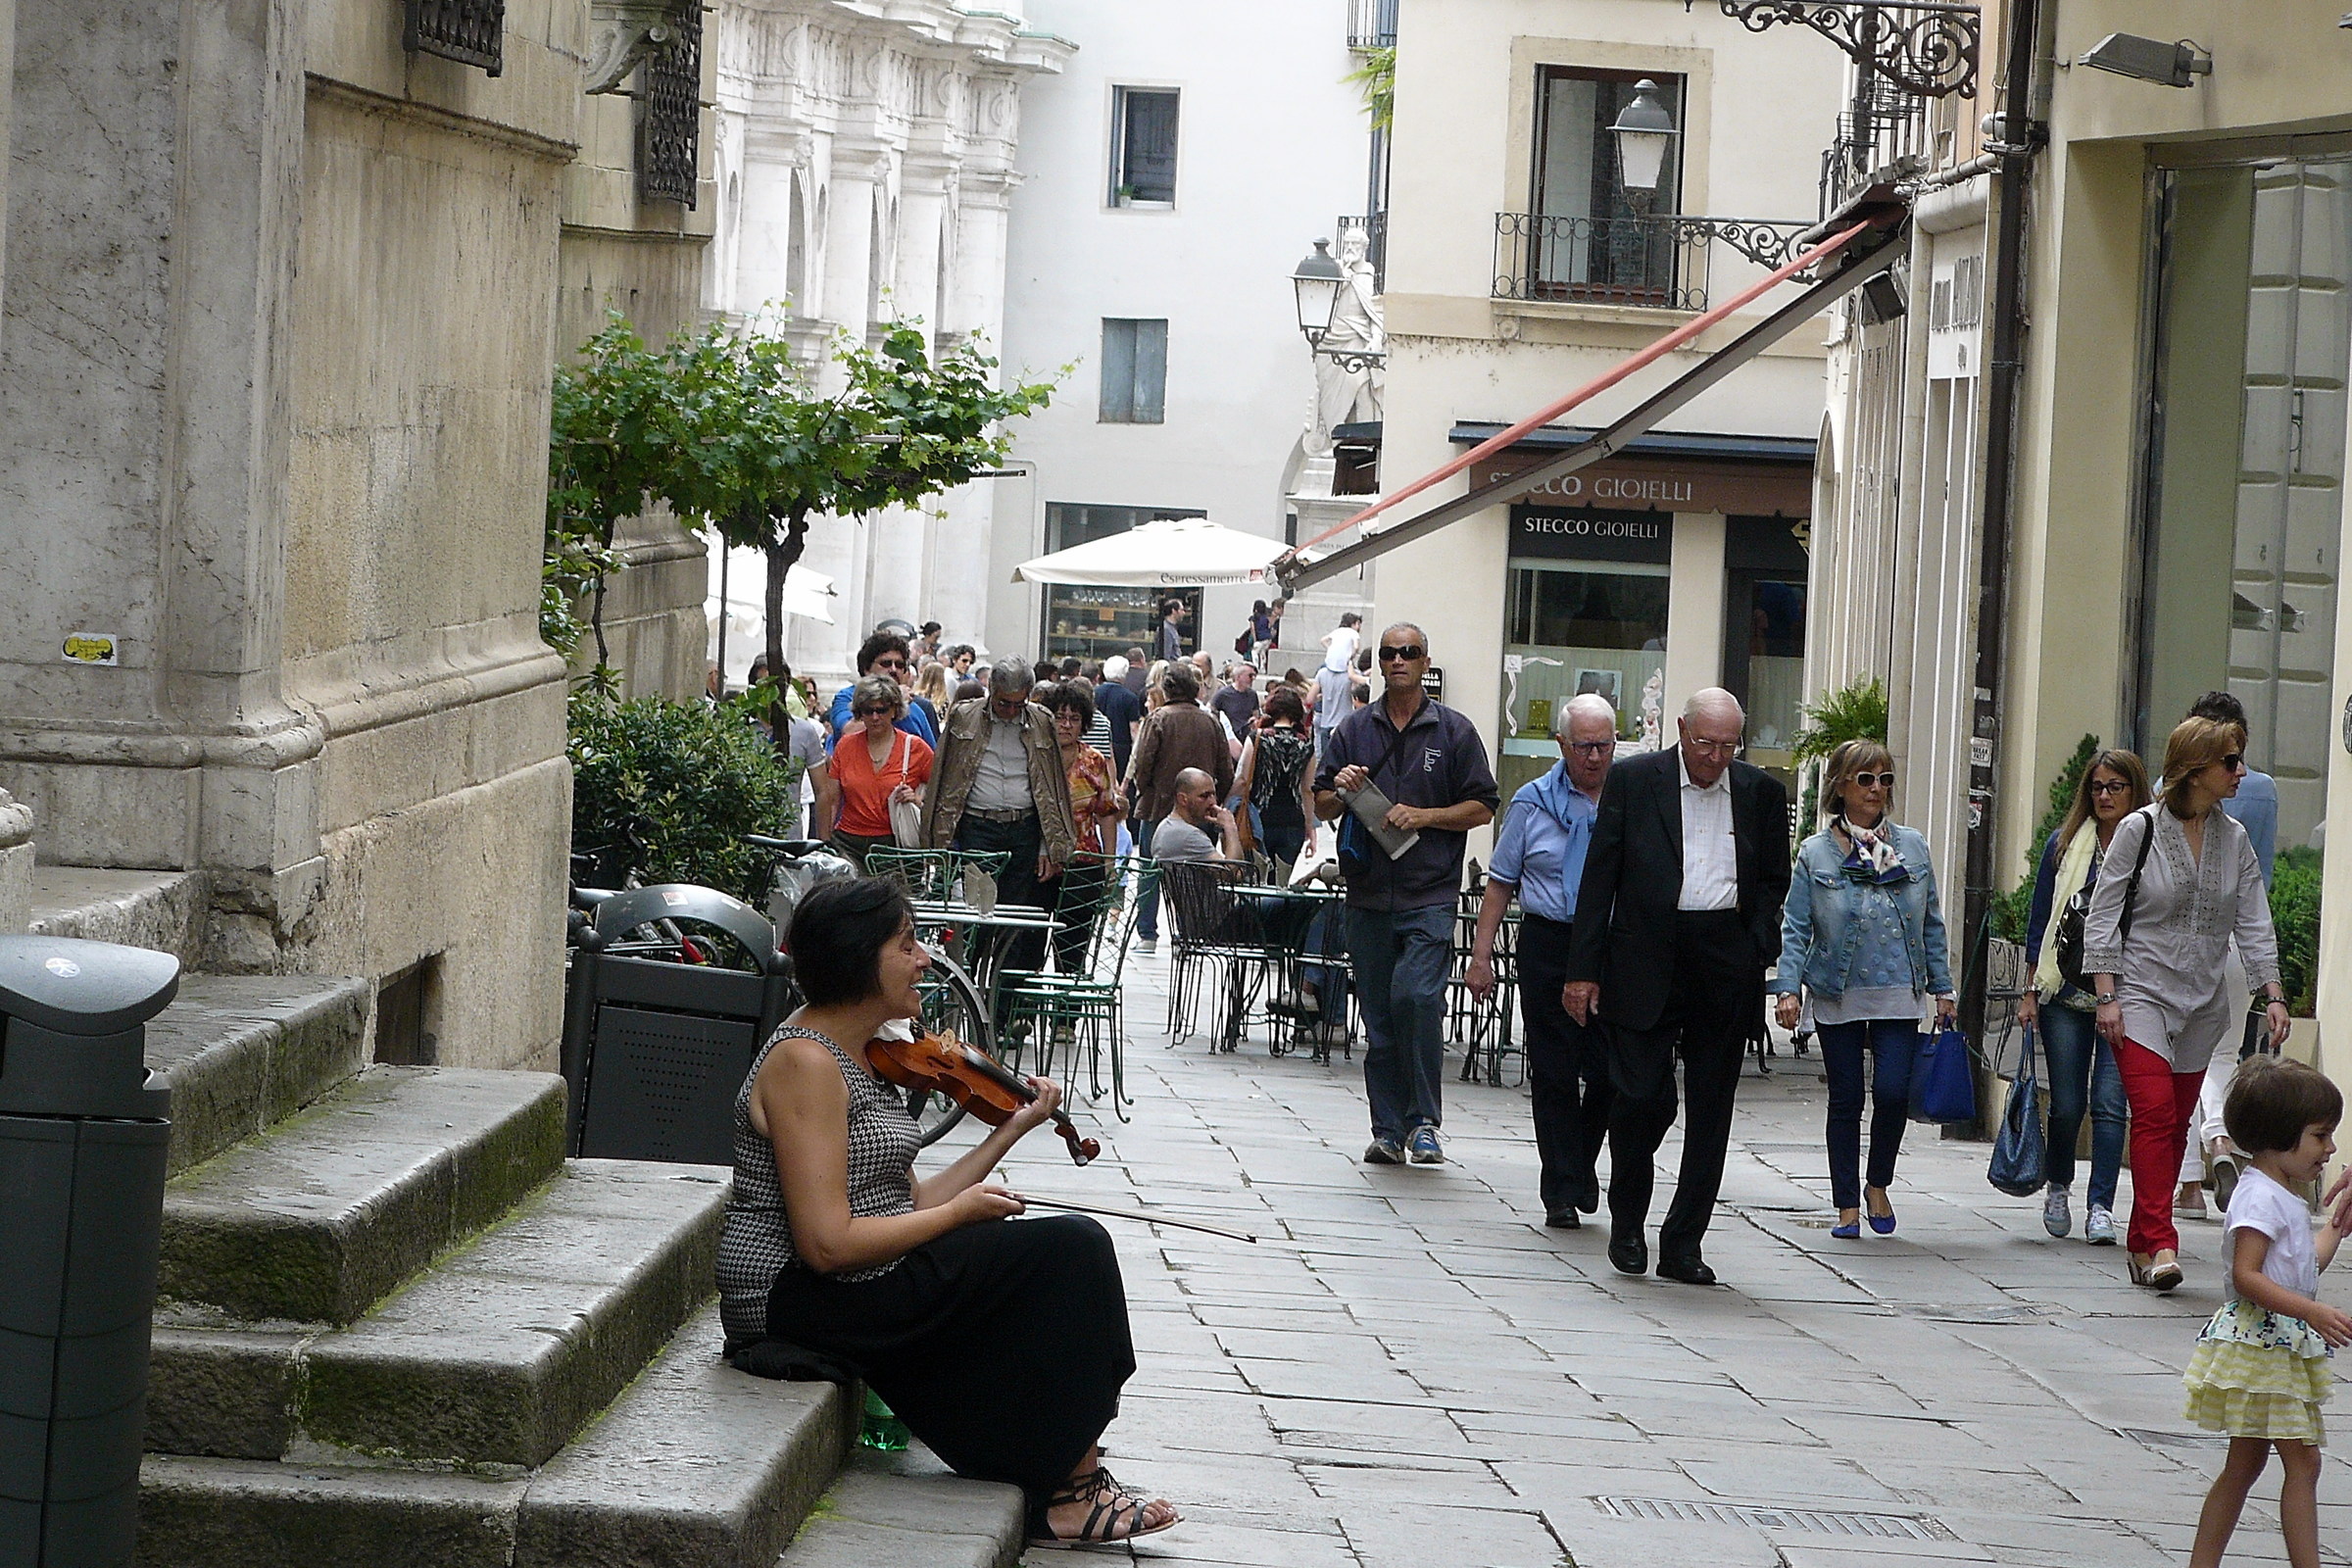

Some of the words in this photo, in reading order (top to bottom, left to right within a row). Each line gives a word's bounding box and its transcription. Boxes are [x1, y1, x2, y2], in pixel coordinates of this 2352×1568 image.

[1594, 477, 1691, 501] GIOIELLI
[1525, 516, 1590, 535] STECCO
[1594, 520, 1658, 539] GIOIELLI
